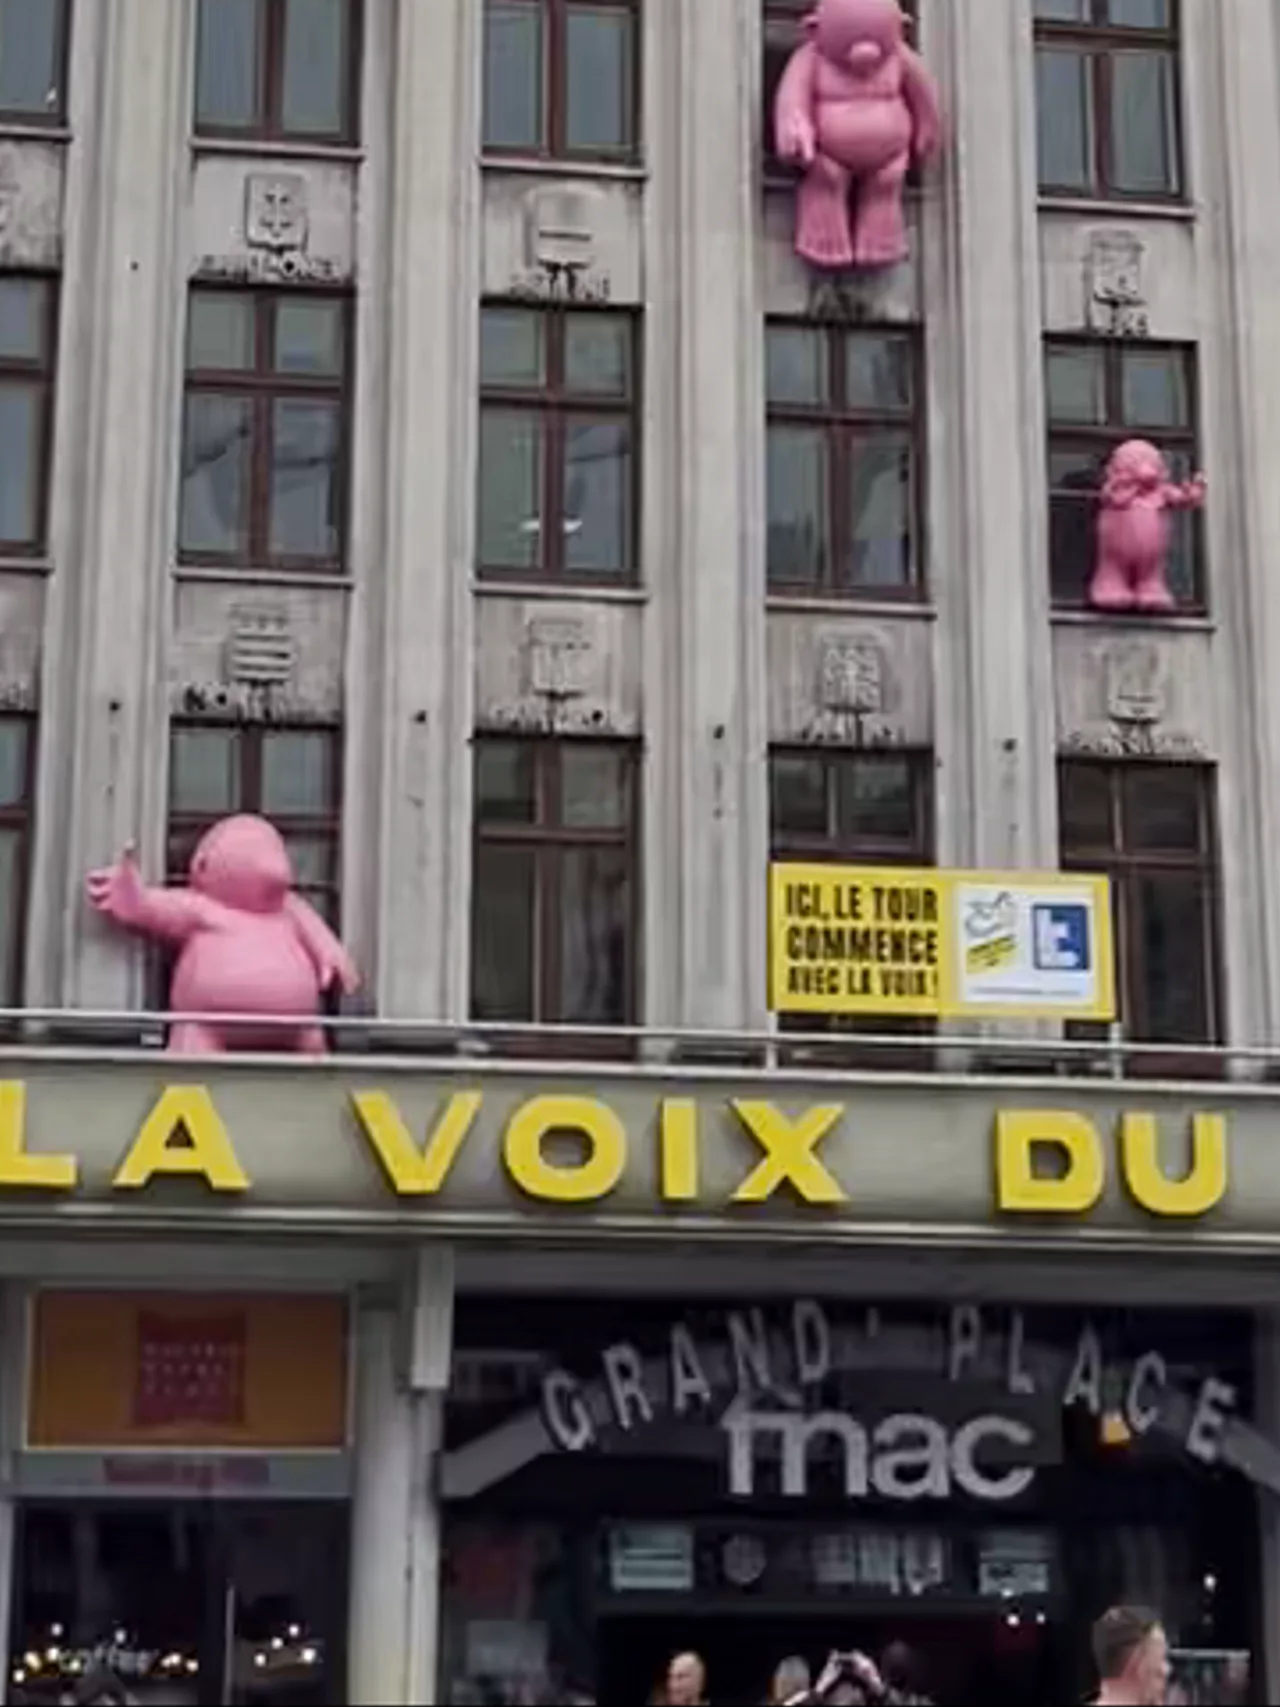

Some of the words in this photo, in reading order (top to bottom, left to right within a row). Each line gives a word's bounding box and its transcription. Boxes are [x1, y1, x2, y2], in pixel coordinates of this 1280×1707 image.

[834, 885, 862, 919] LE
[872, 887, 938, 922] TOUR
[788, 926, 938, 964] COMMENCE
[787, 966, 839, 995] AVEC
[847, 967, 871, 995] LA
[353, 1088, 849, 1205] VOIX
[995, 1108, 1232, 1216] DU
[948, 1304, 1238, 1464] PLACE
